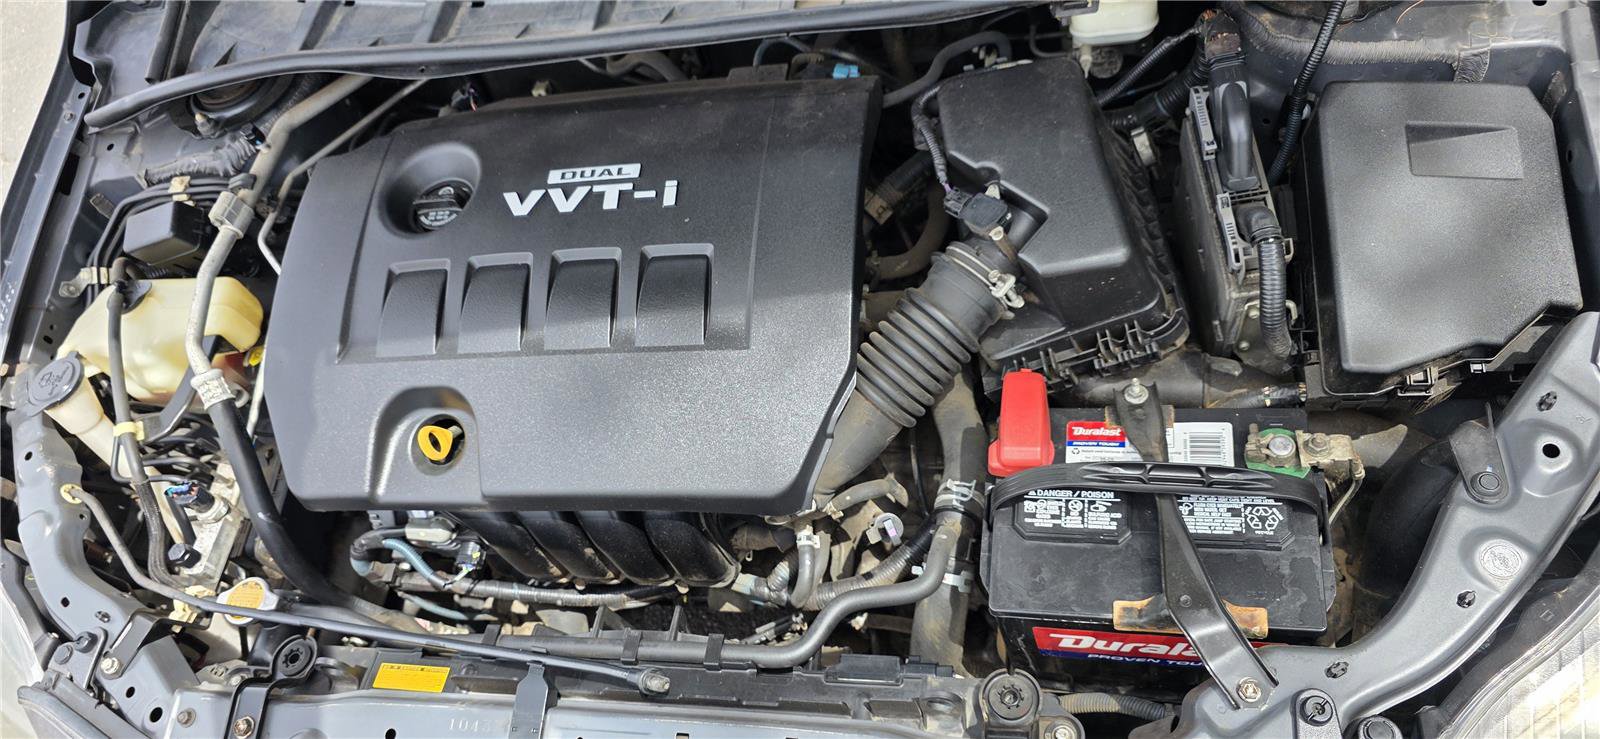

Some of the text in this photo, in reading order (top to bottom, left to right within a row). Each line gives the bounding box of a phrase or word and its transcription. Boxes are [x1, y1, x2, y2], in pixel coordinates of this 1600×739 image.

[560, 167, 631, 180] DUAL
[503, 180, 678, 216] VVT-i
[1072, 426, 1121, 436] Duralast
[1037, 489, 1073, 497] DANGER
[1082, 491, 1114, 499] POISON
[1088, 654, 1160, 664] PROVEN
